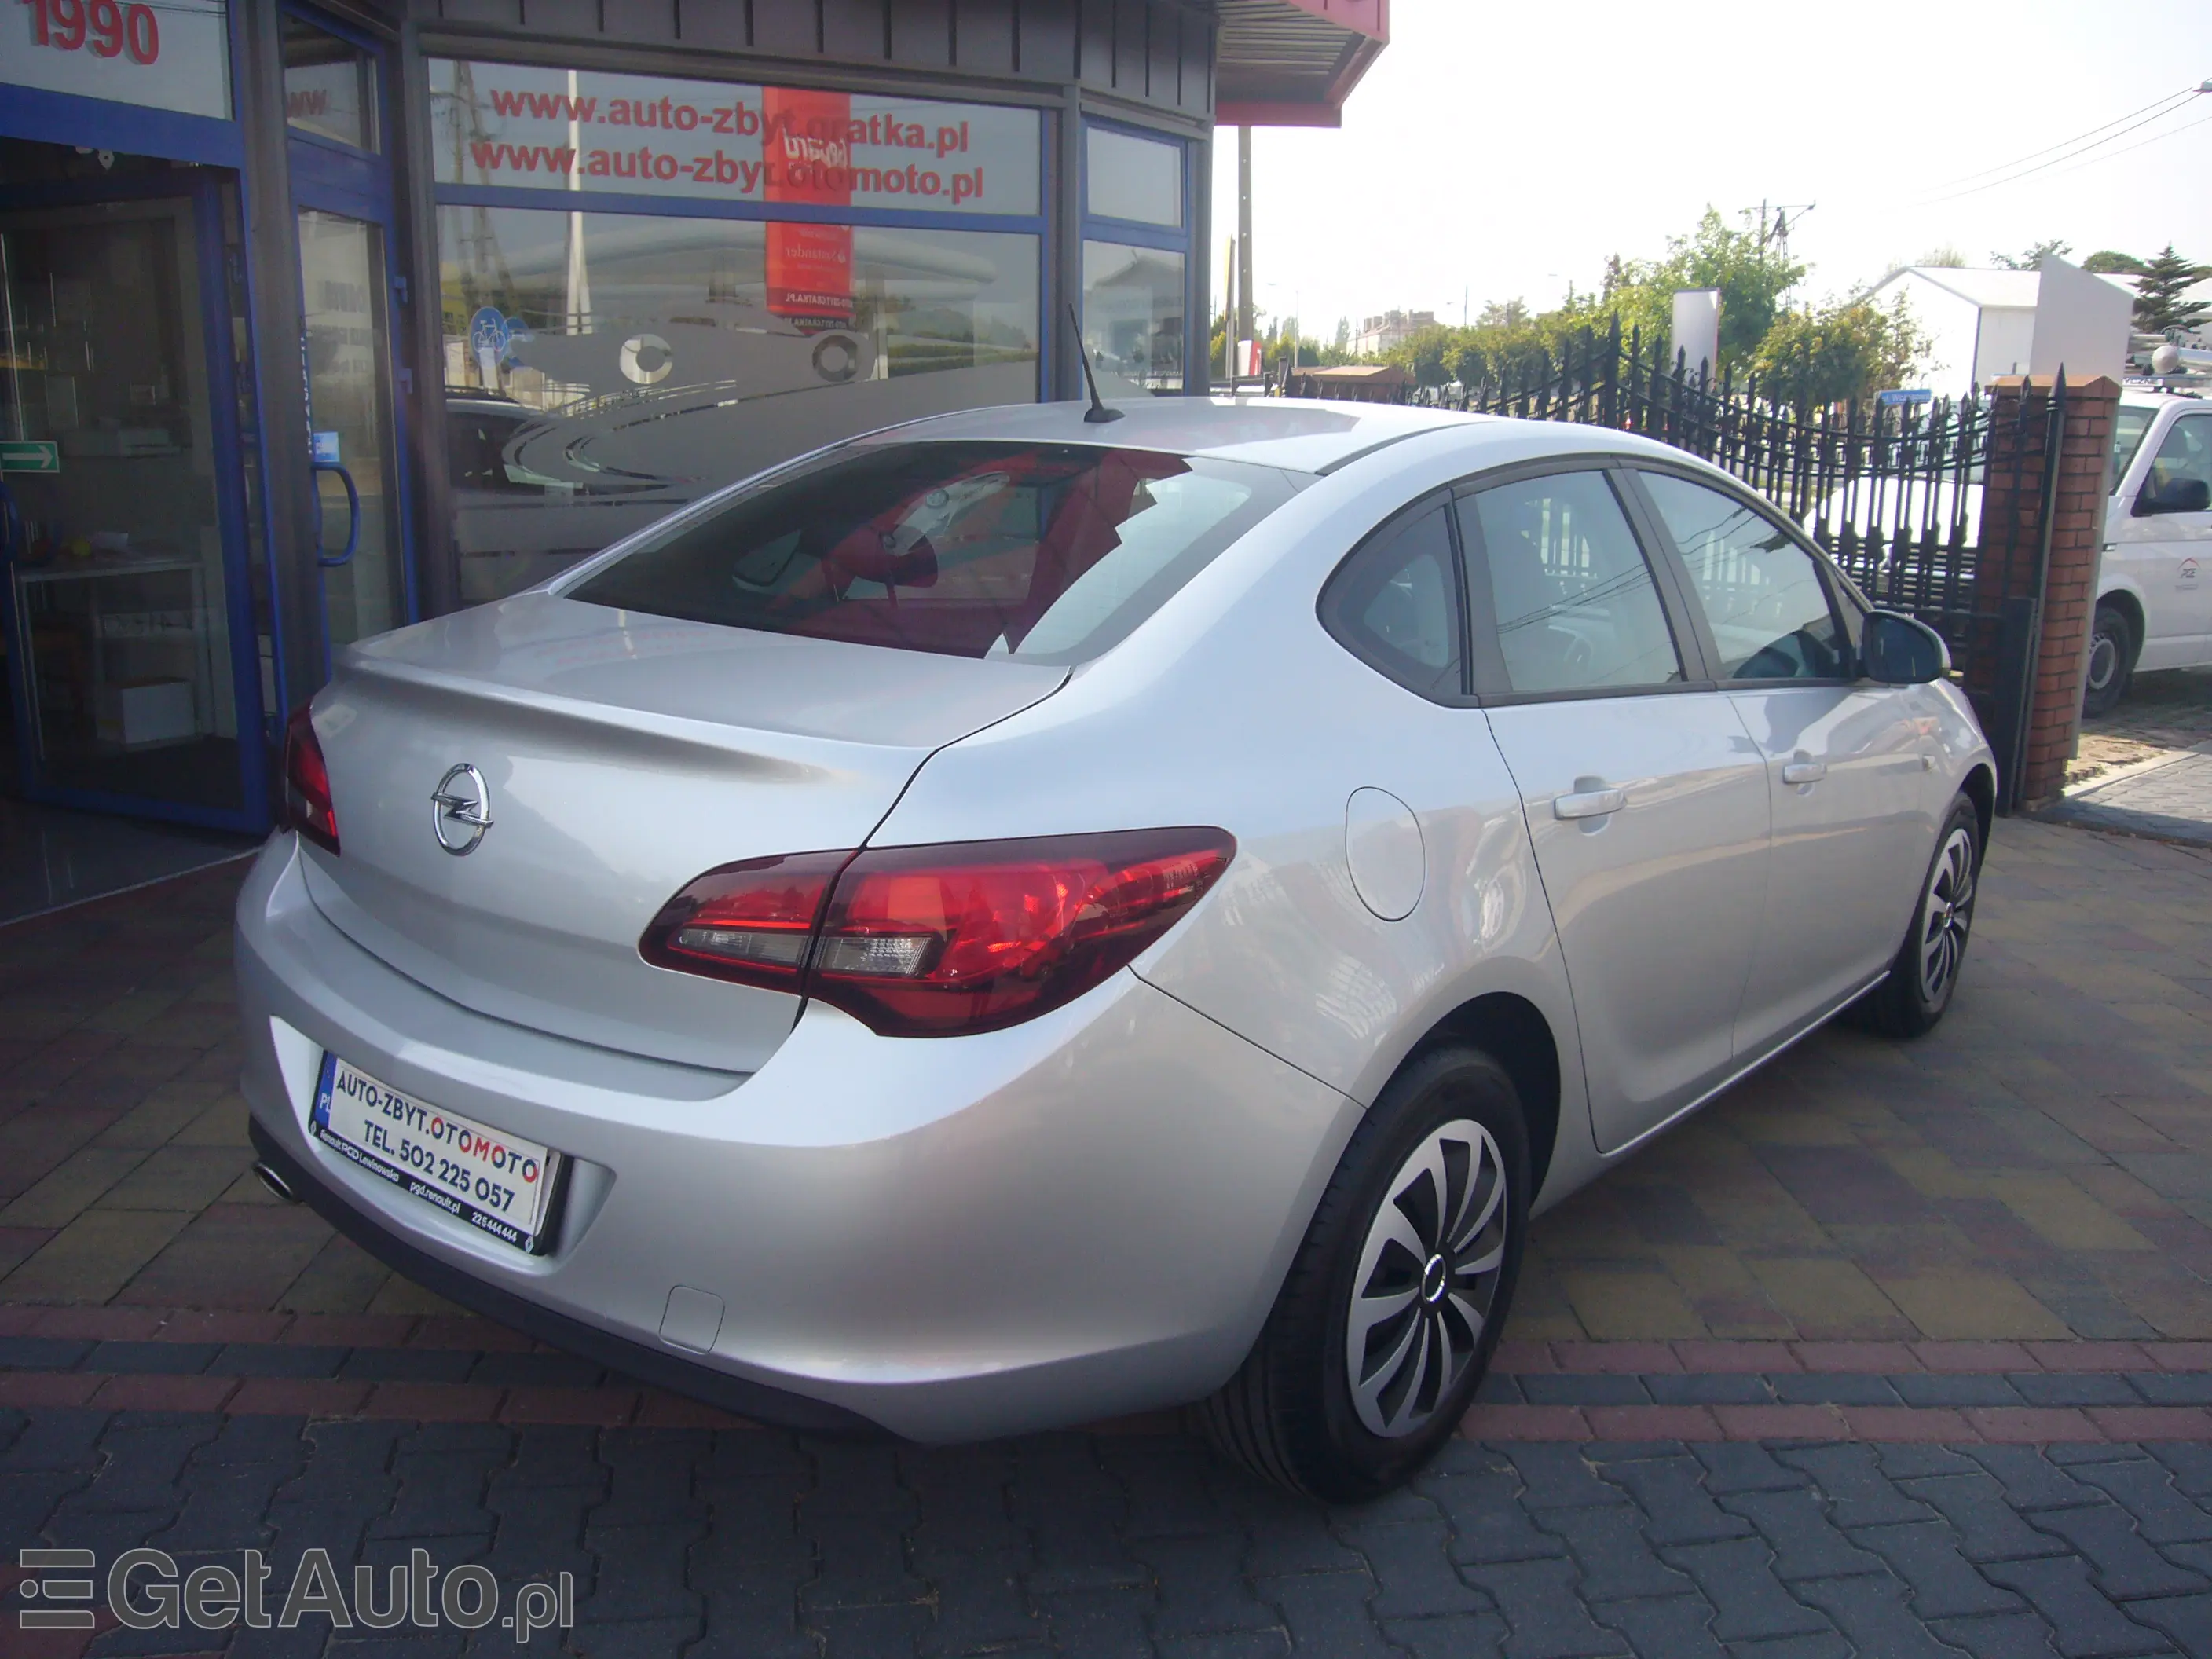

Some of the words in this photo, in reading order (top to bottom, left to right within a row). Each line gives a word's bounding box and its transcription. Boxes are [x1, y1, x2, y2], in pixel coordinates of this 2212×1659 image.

[21, 0, 159, 65] 1990
[336, 1071, 538, 1183] AUTO-ZBYT.OTOMOTO
[364, 1119, 395, 1156] TEL.
[399, 1138, 434, 1176] 502
[438, 1158, 471, 1192] 225
[475, 1177, 515, 1212] 057
